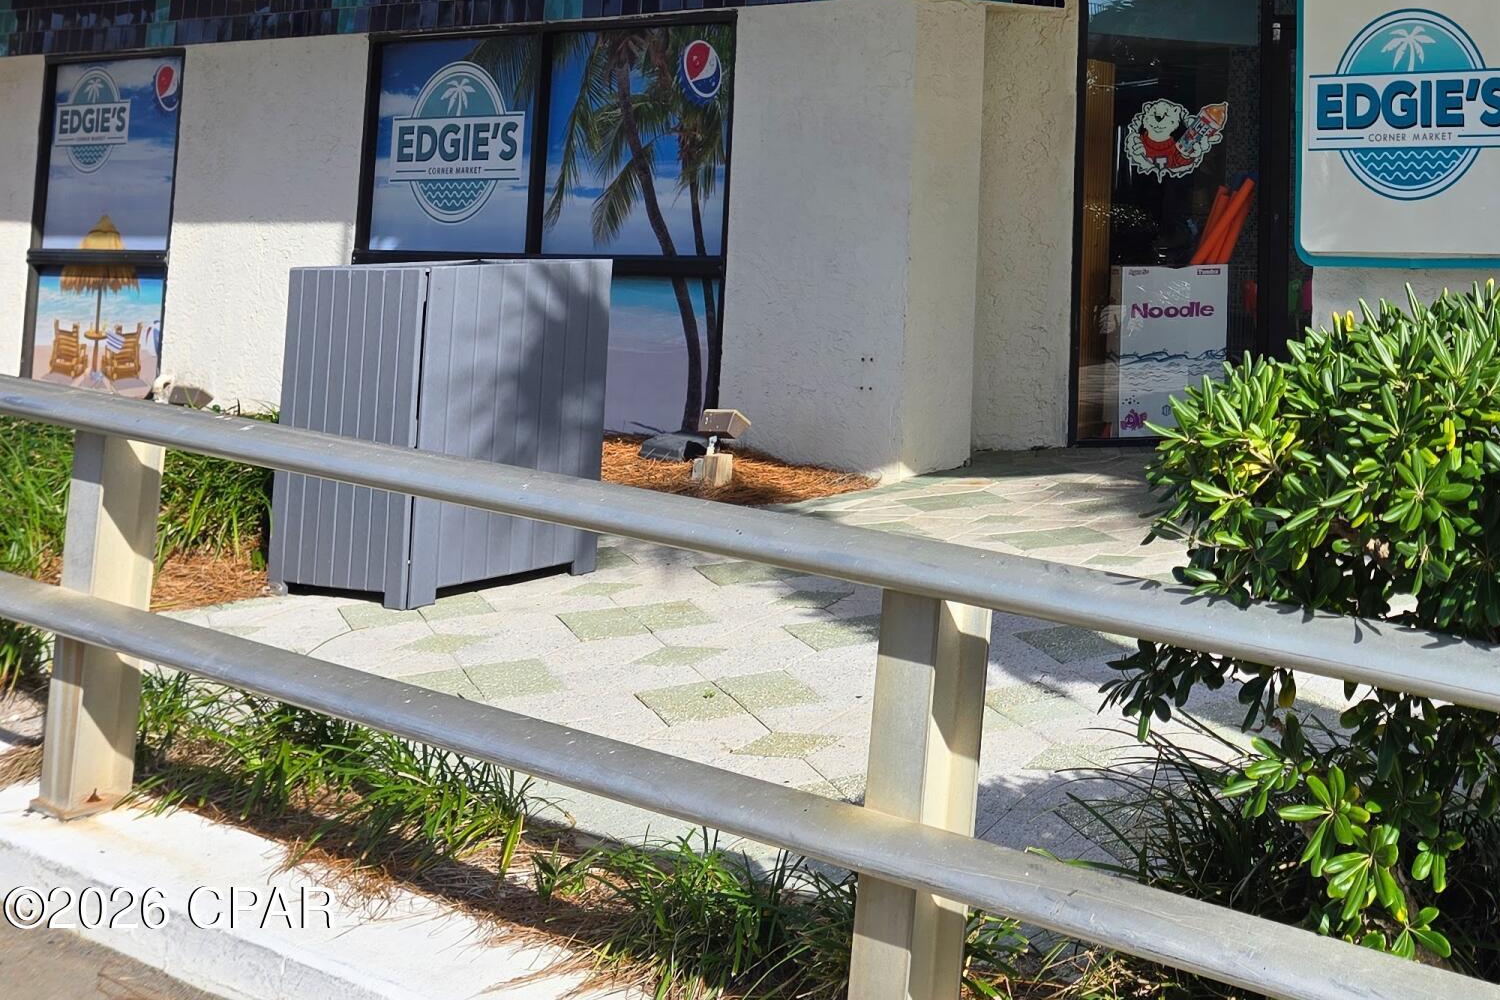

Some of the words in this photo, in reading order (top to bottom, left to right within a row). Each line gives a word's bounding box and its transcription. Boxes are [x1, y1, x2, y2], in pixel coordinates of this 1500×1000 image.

[58, 106, 127, 135] EDGIE'S
[396, 121, 519, 162] EDGIE'S
[1368, 133, 1407, 142] CORNER
[1411, 132, 1453, 141] MARKET
[428, 167, 453, 175] CORNER
[455, 166, 482, 174] MARKET
[1130, 301, 1215, 319] Noodle
